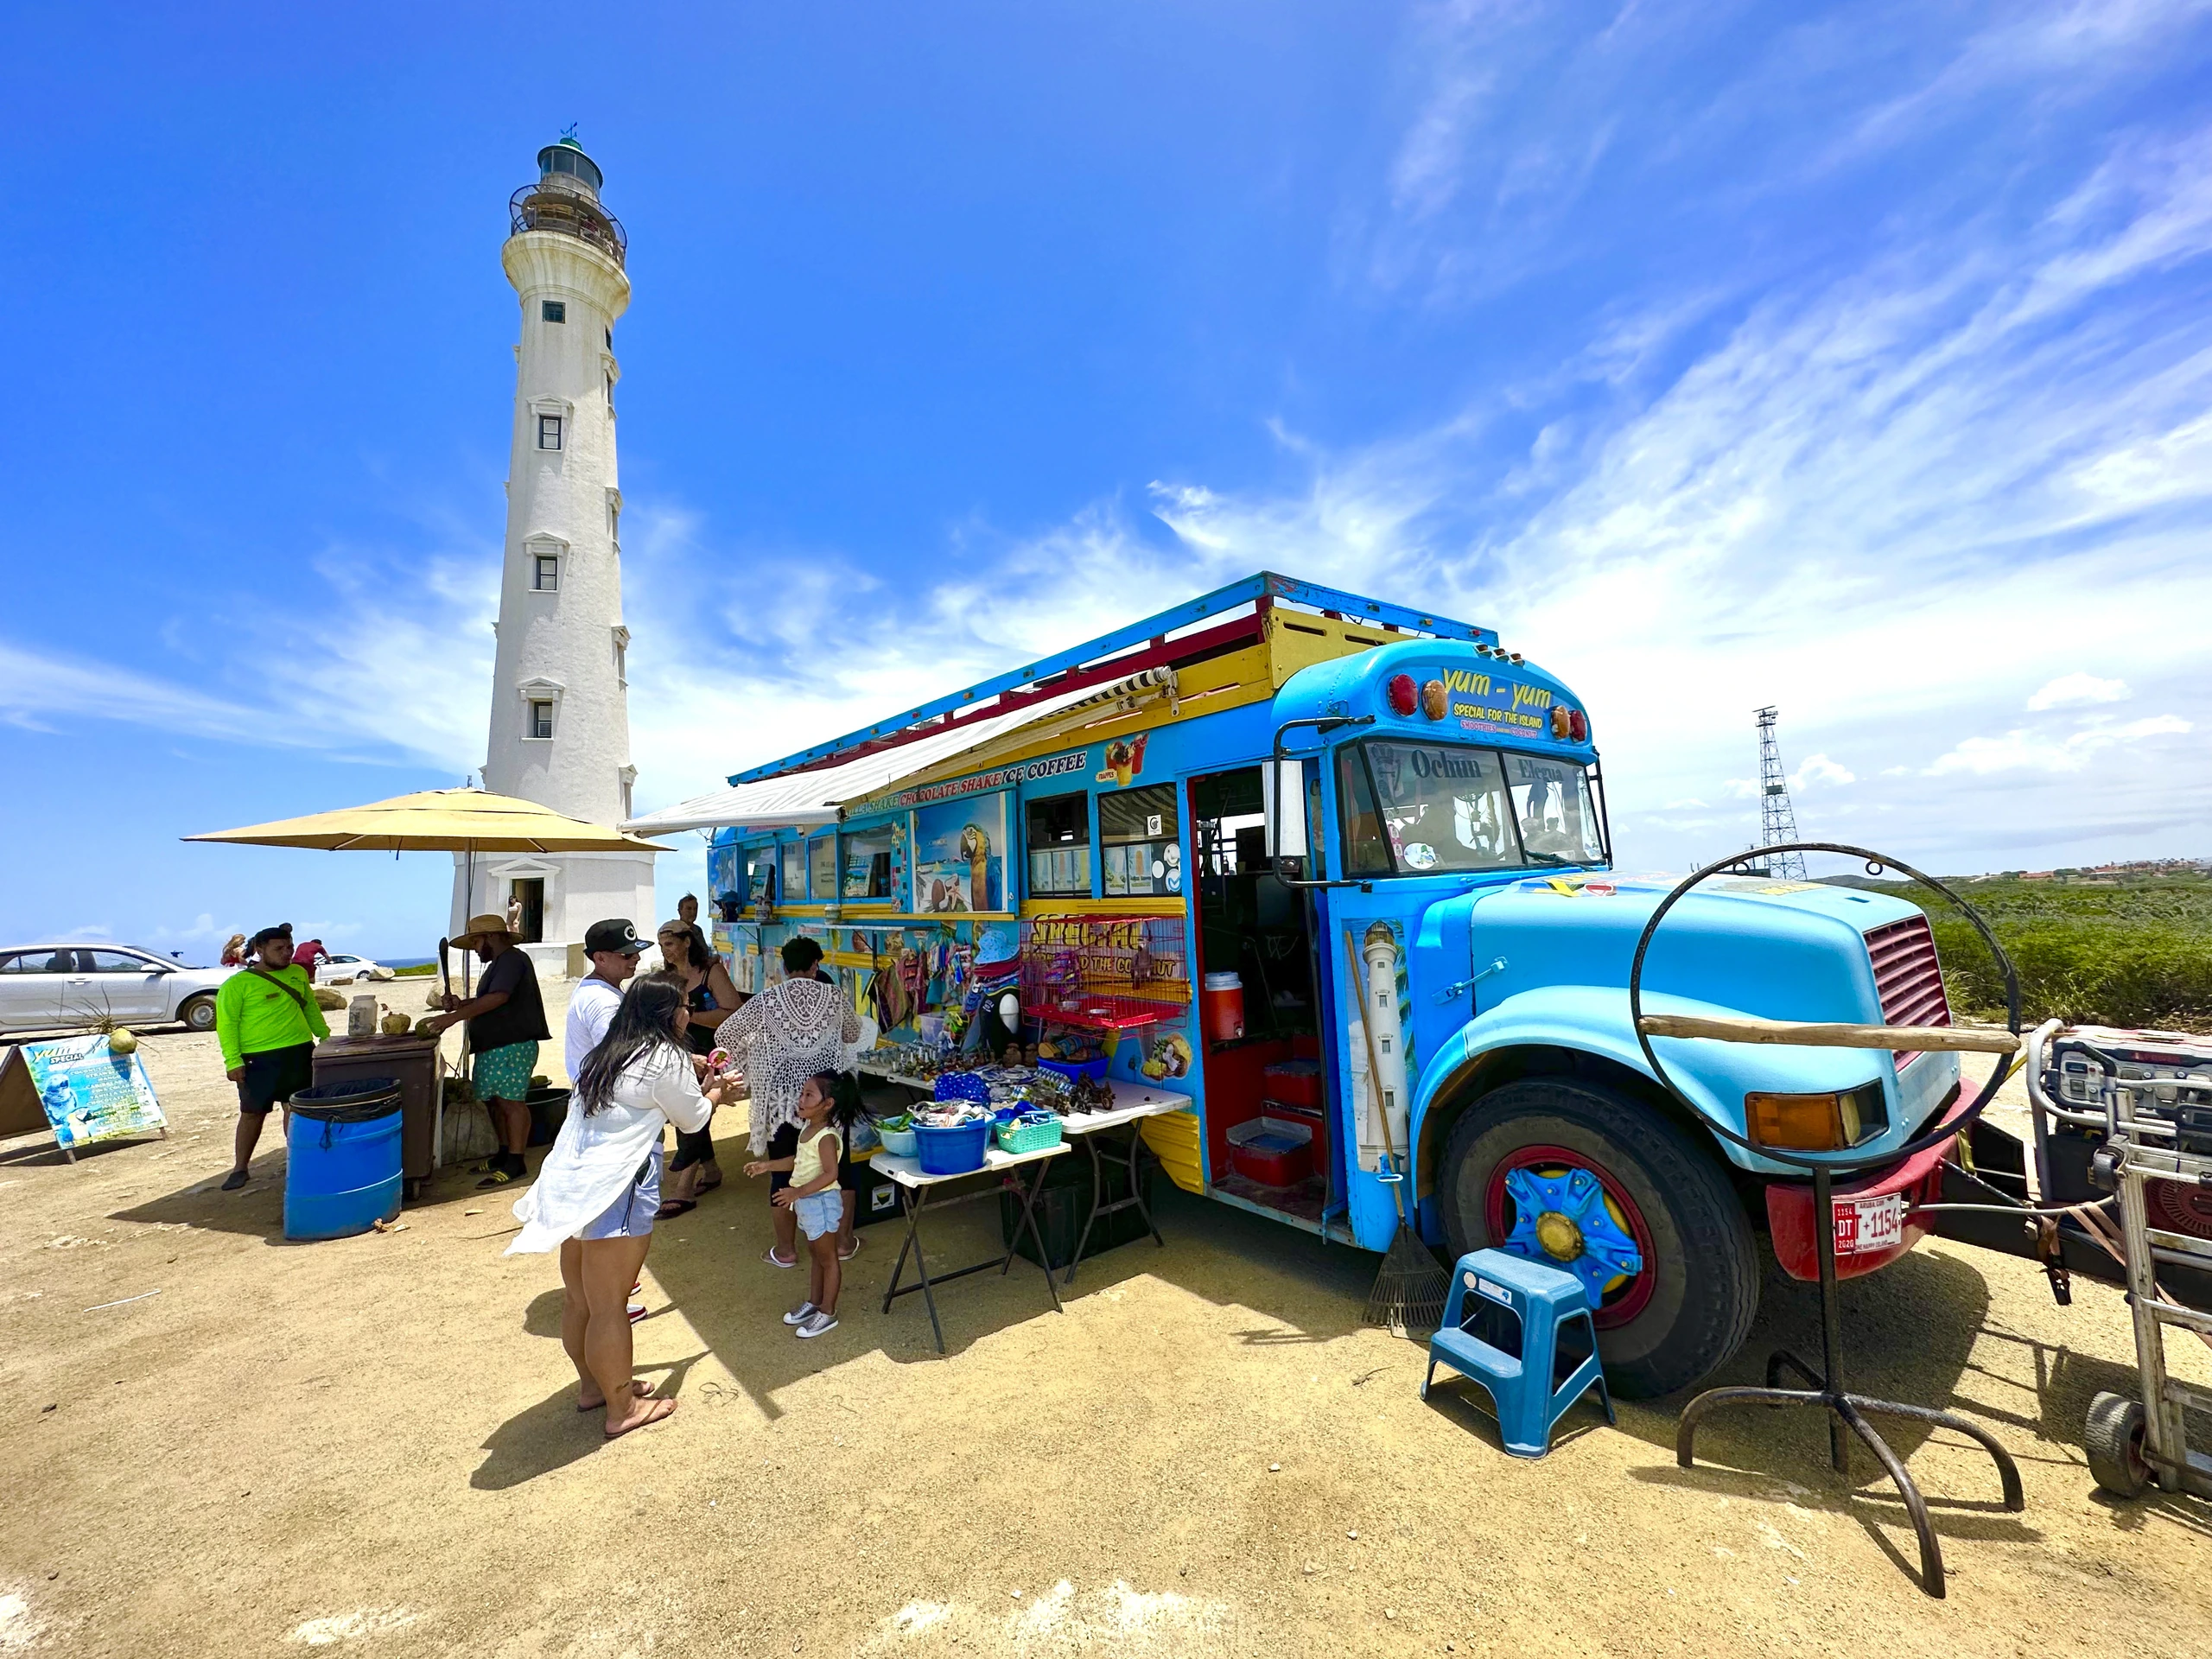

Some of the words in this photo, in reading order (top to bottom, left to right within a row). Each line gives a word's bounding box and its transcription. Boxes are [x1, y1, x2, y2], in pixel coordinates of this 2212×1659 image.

[1443, 667, 1491, 697] yum
[1510, 682, 1552, 711] yum
[1454, 703, 1485, 720] SPECIAL
[1488, 709, 1502, 722] FOR
[1504, 710, 1517, 724] THE
[1519, 714, 1542, 729] ISLAND
[1460, 721, 1497, 733] SMOOTHIES
[1510, 728, 1537, 738] COCONUT
[1002, 766, 1024, 785] ICE
[1027, 752, 1086, 779] COFFEE
[1410, 749, 1482, 779] Ochun
[899, 780, 958, 806] CHOCOLATE
[960, 772, 1002, 793] SHAKE
[869, 794, 899, 812] SHAKE
[49, 1052, 85, 1065] SPECIAL
[1838, 1219, 1853, 1236] DT
[1839, 1240, 1854, 1249] 2020
